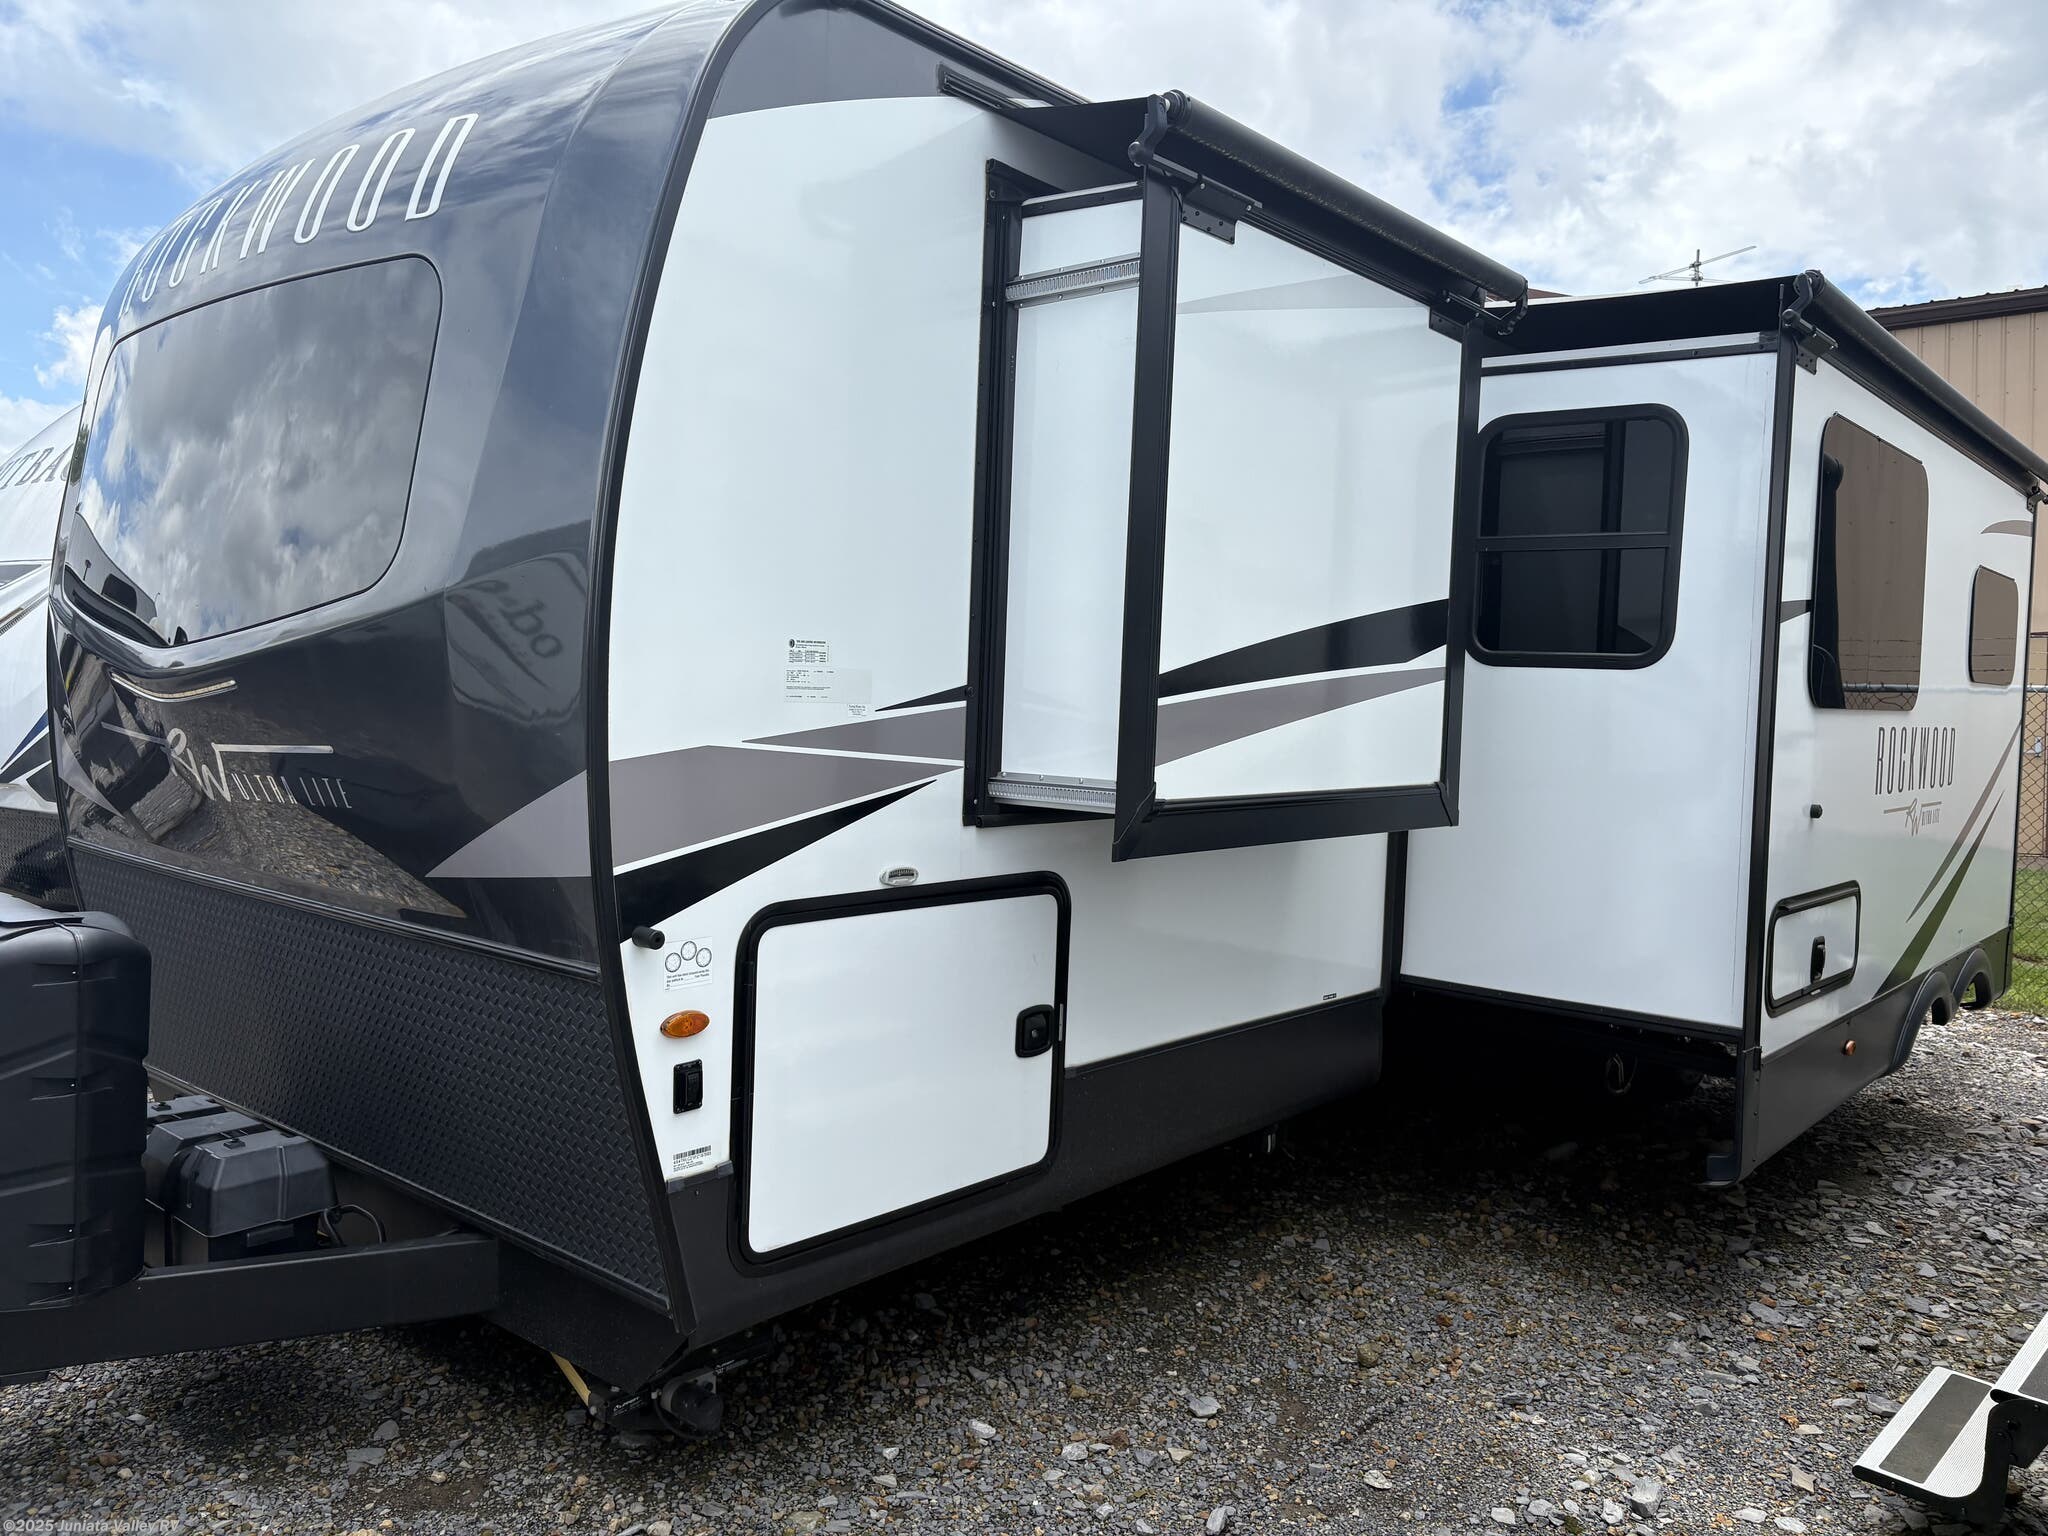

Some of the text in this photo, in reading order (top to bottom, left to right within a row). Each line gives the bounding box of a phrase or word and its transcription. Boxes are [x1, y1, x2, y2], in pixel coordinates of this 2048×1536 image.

[117, 112, 480, 320] ROCKWOOD
[231, 773, 298, 804] ULTRA
[299, 777, 353, 808] LITE
[1874, 726, 1956, 795] ROCKWOOD
